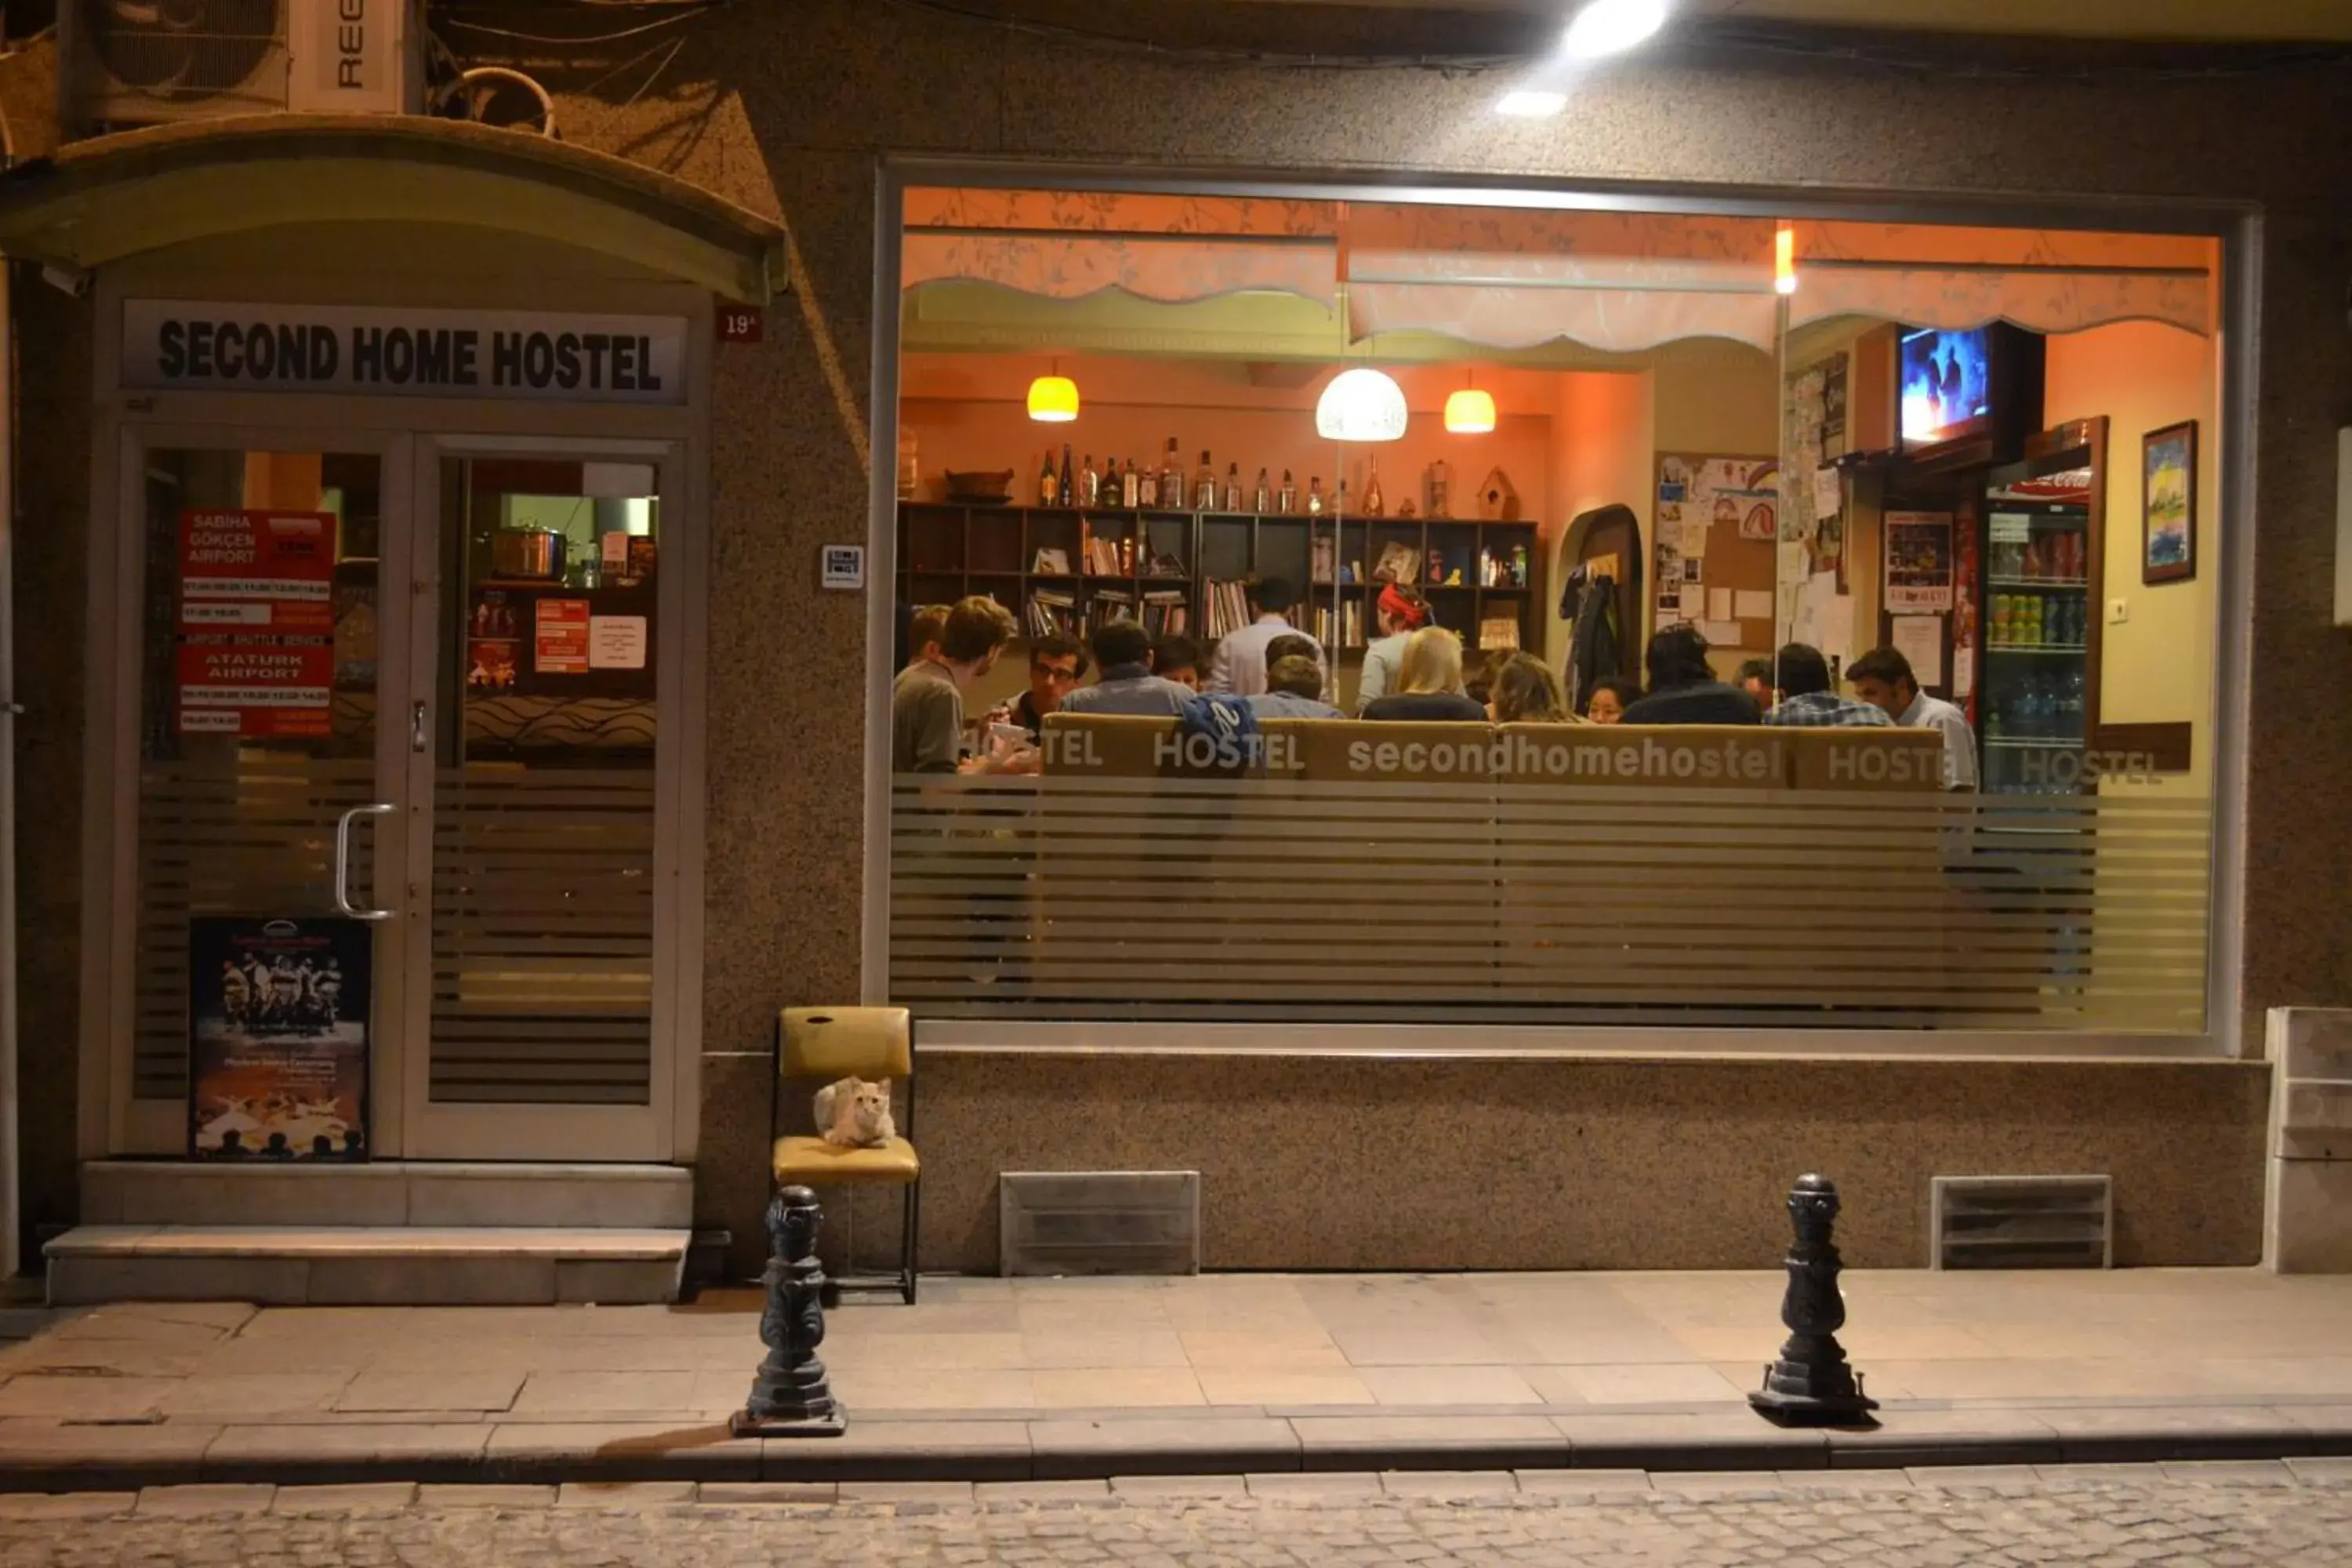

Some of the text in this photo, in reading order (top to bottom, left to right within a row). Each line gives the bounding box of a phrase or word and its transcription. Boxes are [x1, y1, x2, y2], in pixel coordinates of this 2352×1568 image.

[159, 320, 661, 390] SECOND HOME HOSTEL
[188, 550, 256, 564] AIRPORT
[207, 667, 302, 679] AIRPORT
[1154, 731, 1305, 770] HOSTEL
[1348, 735, 1782, 779] secondhomehostel
[2021, 750, 2163, 786] HOSTEL
